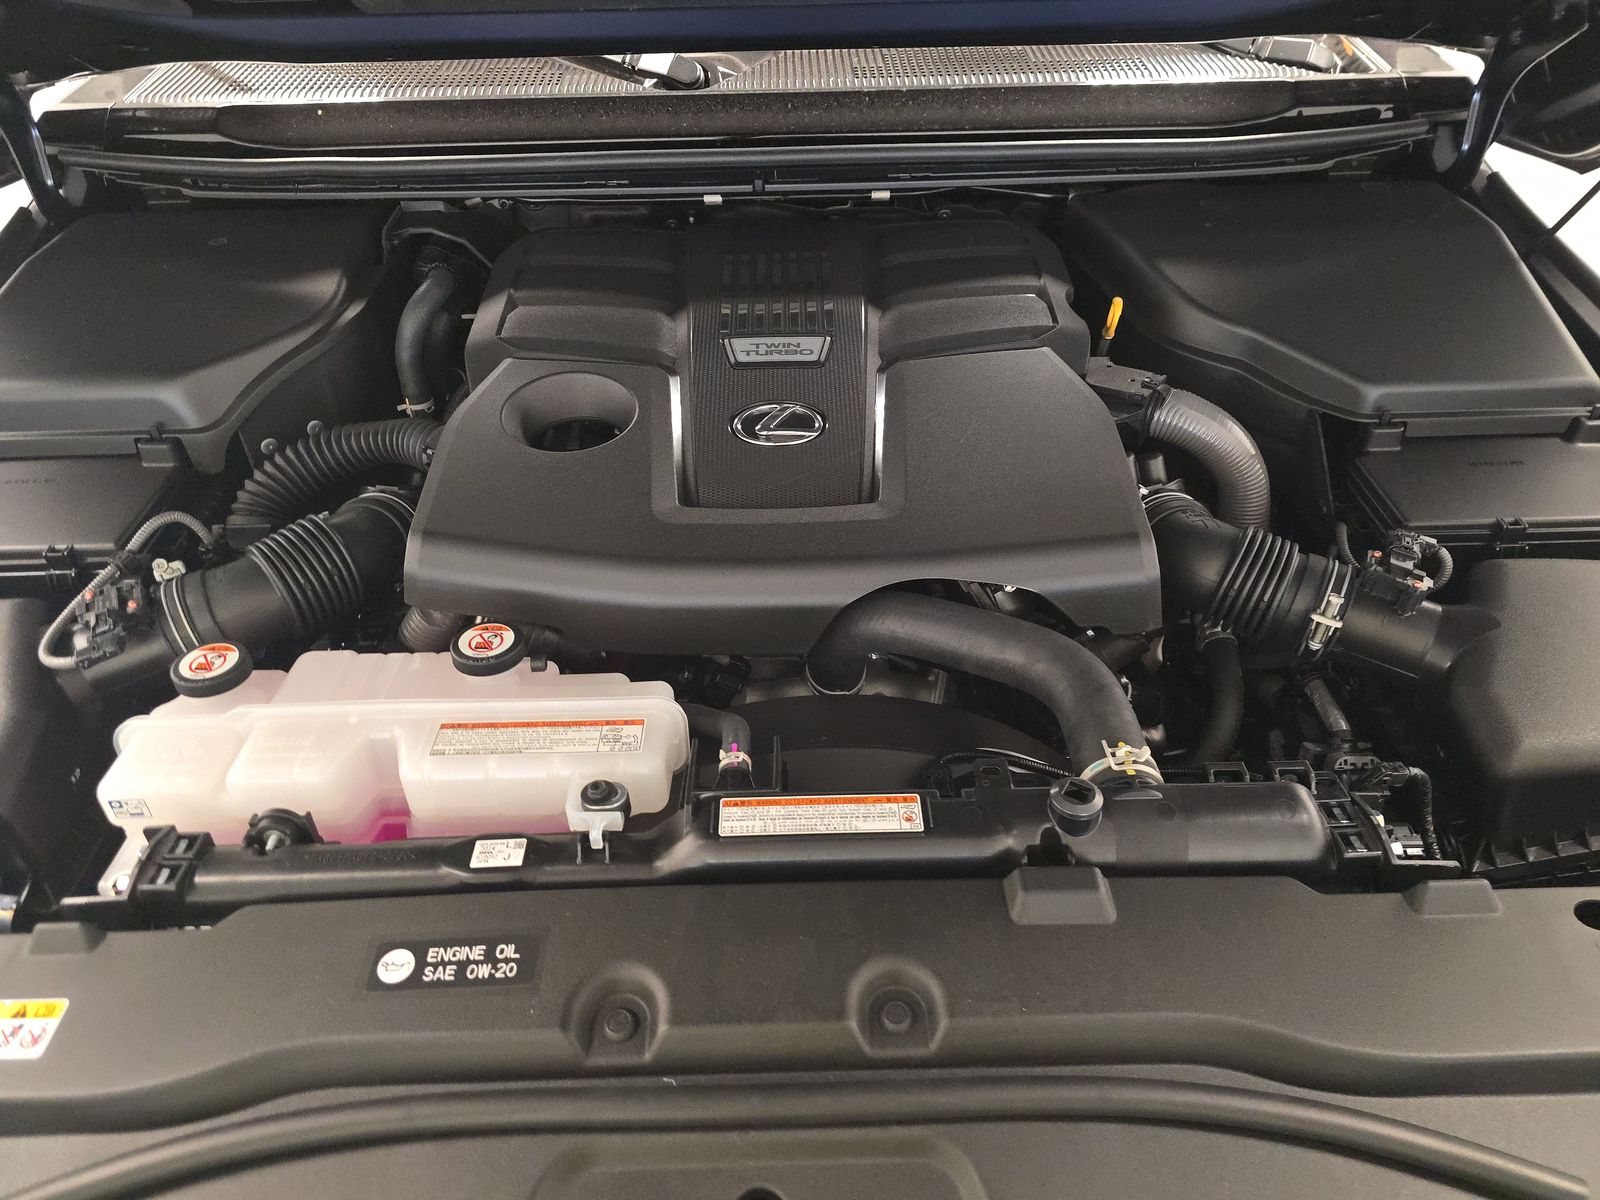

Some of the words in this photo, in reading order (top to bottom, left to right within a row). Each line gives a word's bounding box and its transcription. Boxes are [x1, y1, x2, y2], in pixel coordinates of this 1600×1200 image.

[740, 348, 814, 356] TURBO
[426, 945, 487, 963] ENGINE
[495, 944, 520, 959] OIL
[422, 965, 457, 982] SAE
[466, 962, 518, 980] 0W-20
